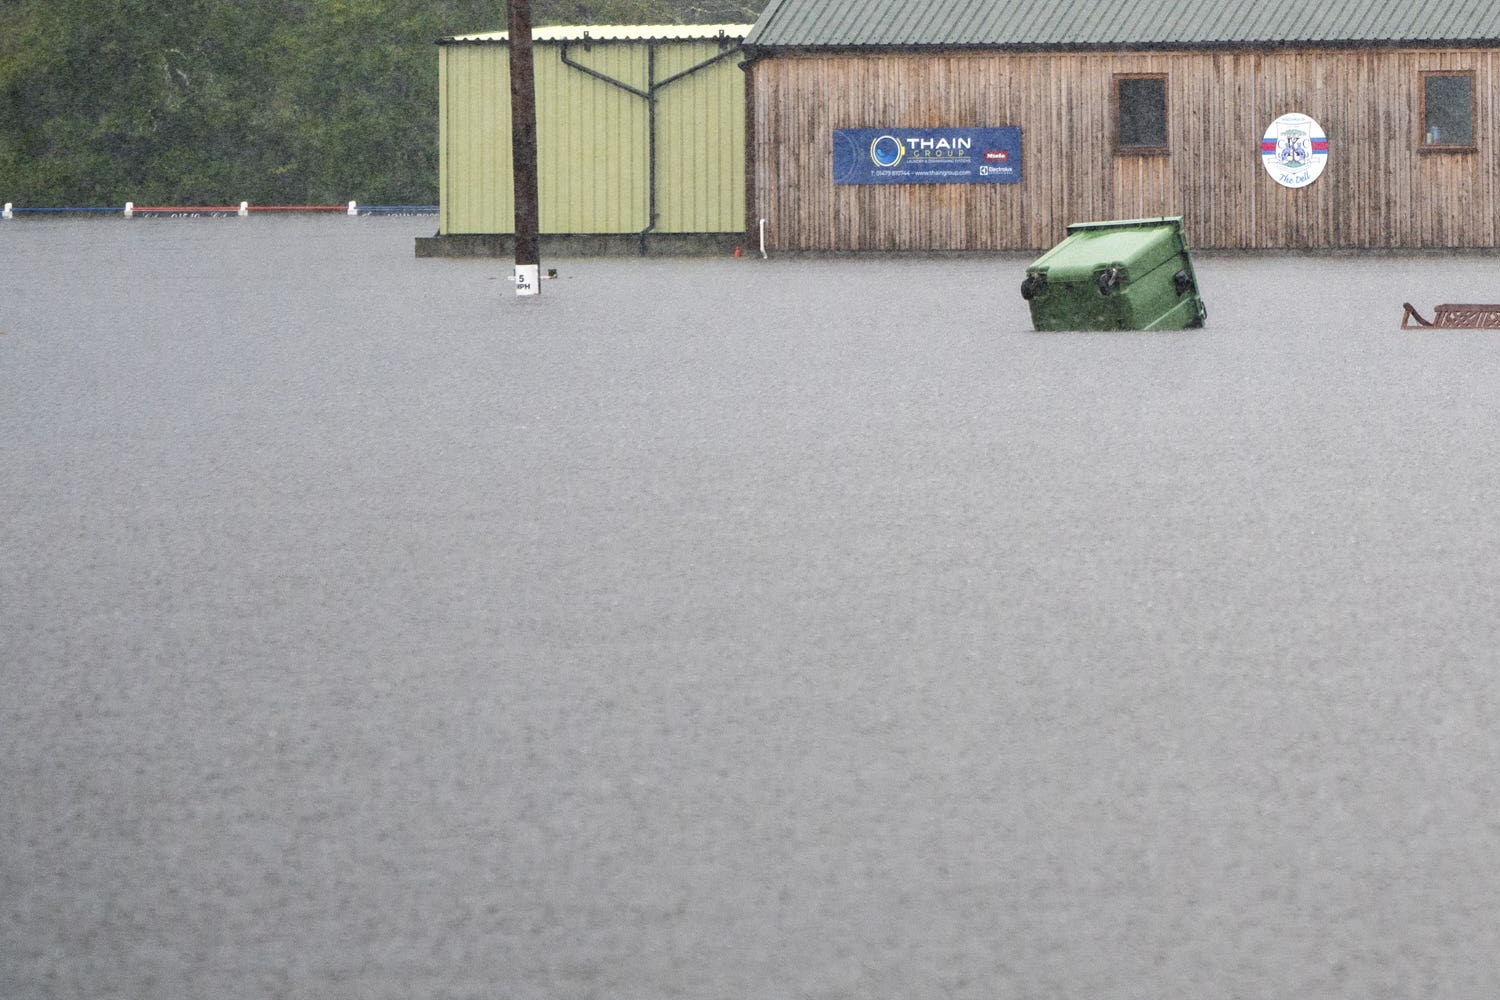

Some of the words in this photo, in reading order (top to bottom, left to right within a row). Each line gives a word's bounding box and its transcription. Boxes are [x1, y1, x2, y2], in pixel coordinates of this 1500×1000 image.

[906, 137, 971, 150] THAIN
[913, 150, 965, 158] GROUP
[1280, 173, 1294, 184] The
[1296, 171, 1311, 184] Dell
